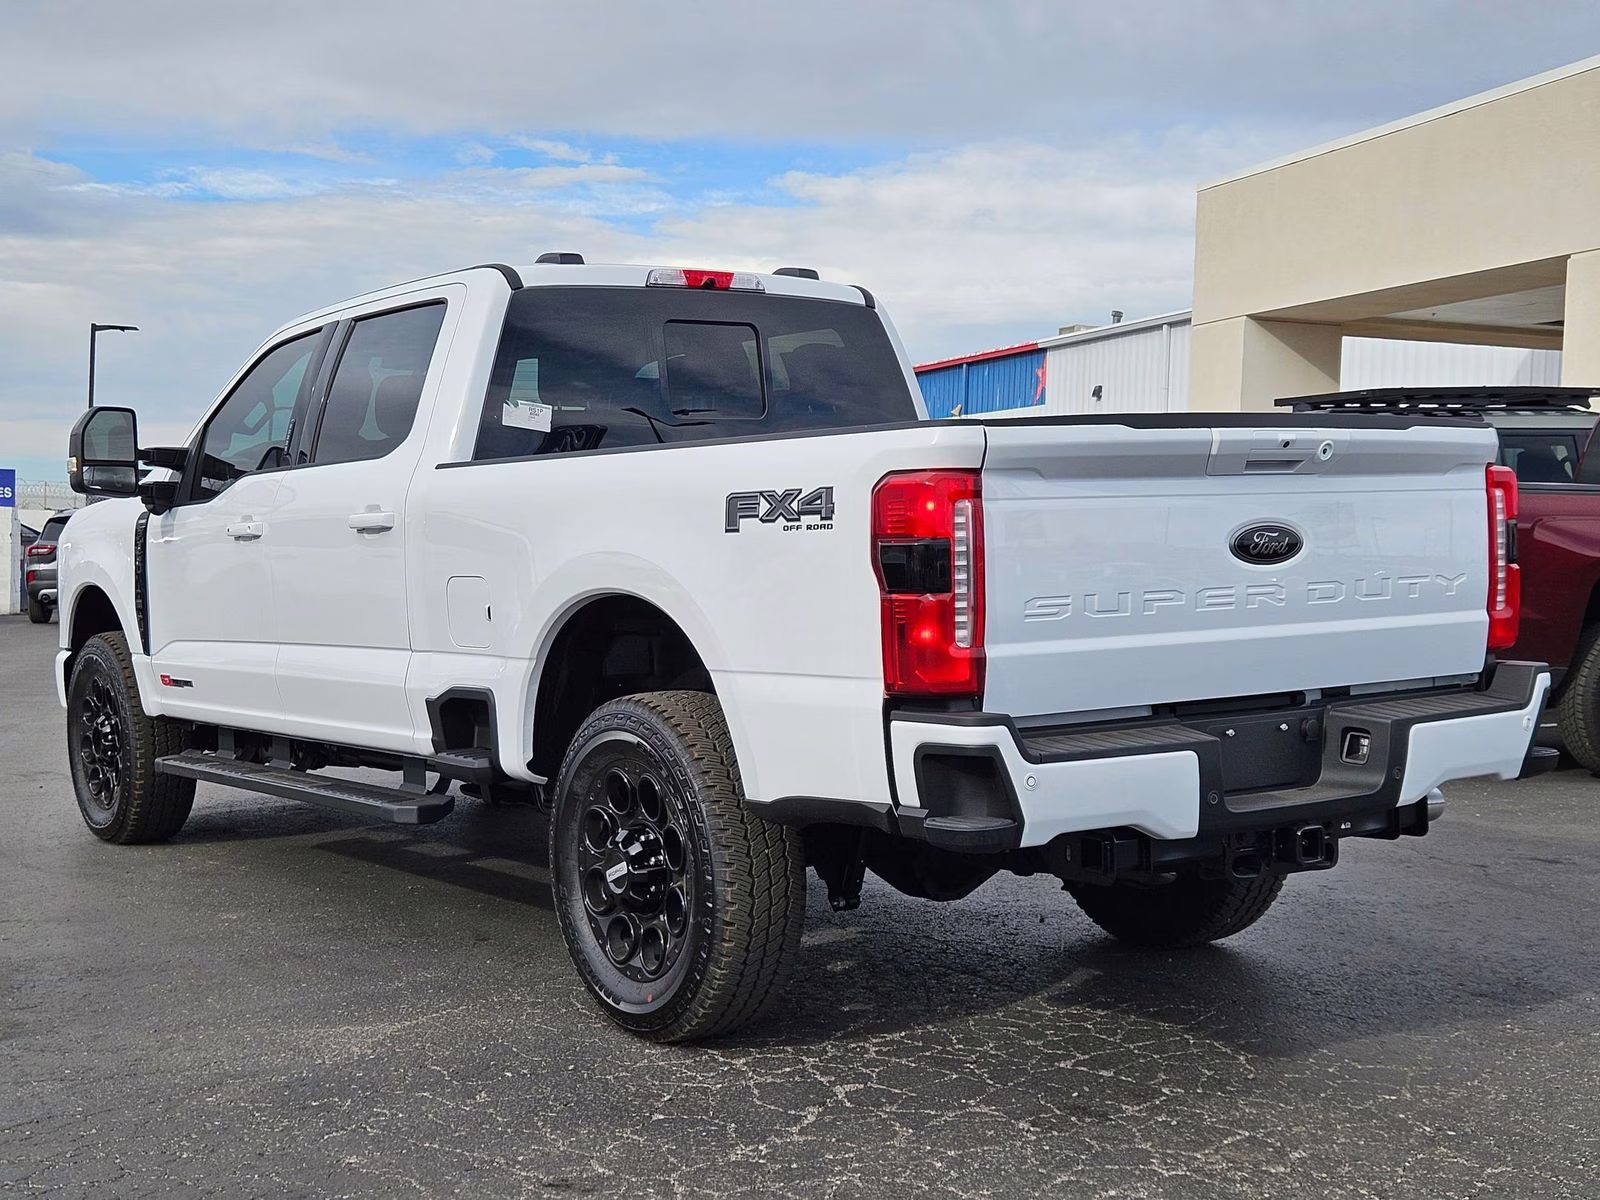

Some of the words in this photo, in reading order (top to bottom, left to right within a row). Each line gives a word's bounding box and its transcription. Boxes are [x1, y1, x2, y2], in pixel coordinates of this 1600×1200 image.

[725, 486, 834, 533] FX4
[783, 524, 802, 532] OFF
[806, 523, 834, 531] ROAD
[1250, 531, 1289, 555] Ford
[1024, 584, 1285, 622] SUPER
[1307, 573, 1467, 605] DUTY
